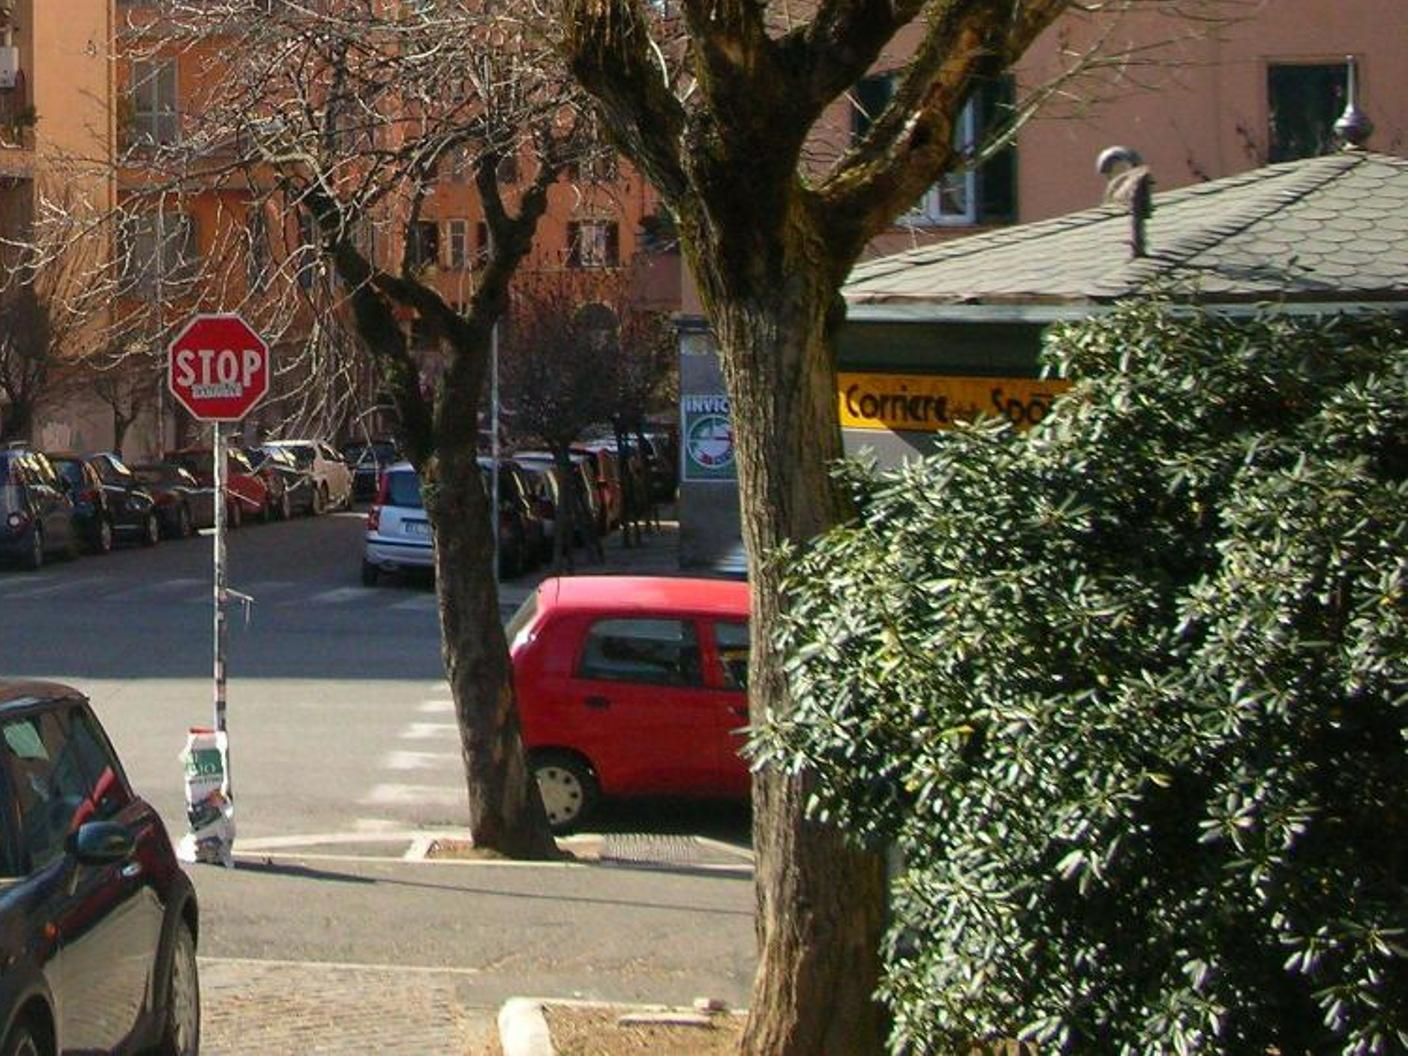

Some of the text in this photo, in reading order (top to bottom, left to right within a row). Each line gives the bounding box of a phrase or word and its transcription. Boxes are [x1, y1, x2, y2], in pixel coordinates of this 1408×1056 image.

[176, 349, 262, 387] STOP
[846, 384, 949, 424] Corriere
[992, 388, 1054, 424] Spo
